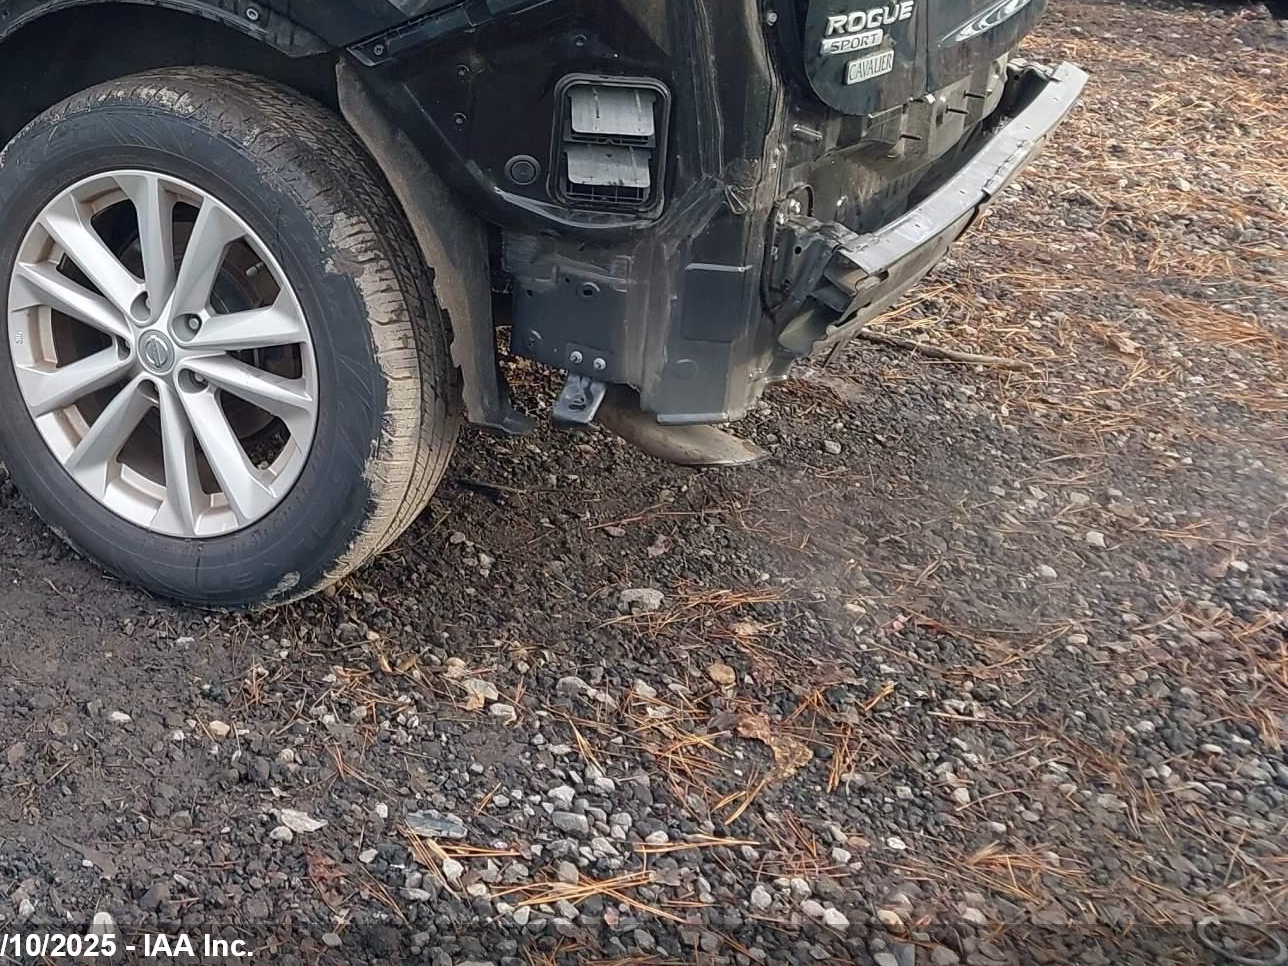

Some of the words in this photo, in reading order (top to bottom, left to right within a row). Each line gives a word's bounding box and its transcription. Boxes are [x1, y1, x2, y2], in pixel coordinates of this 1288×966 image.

[824, 0, 914, 36] ROGUE
[829, 34, 879, 54] SPORT
[848, 52, 893, 82] CAVALIER
